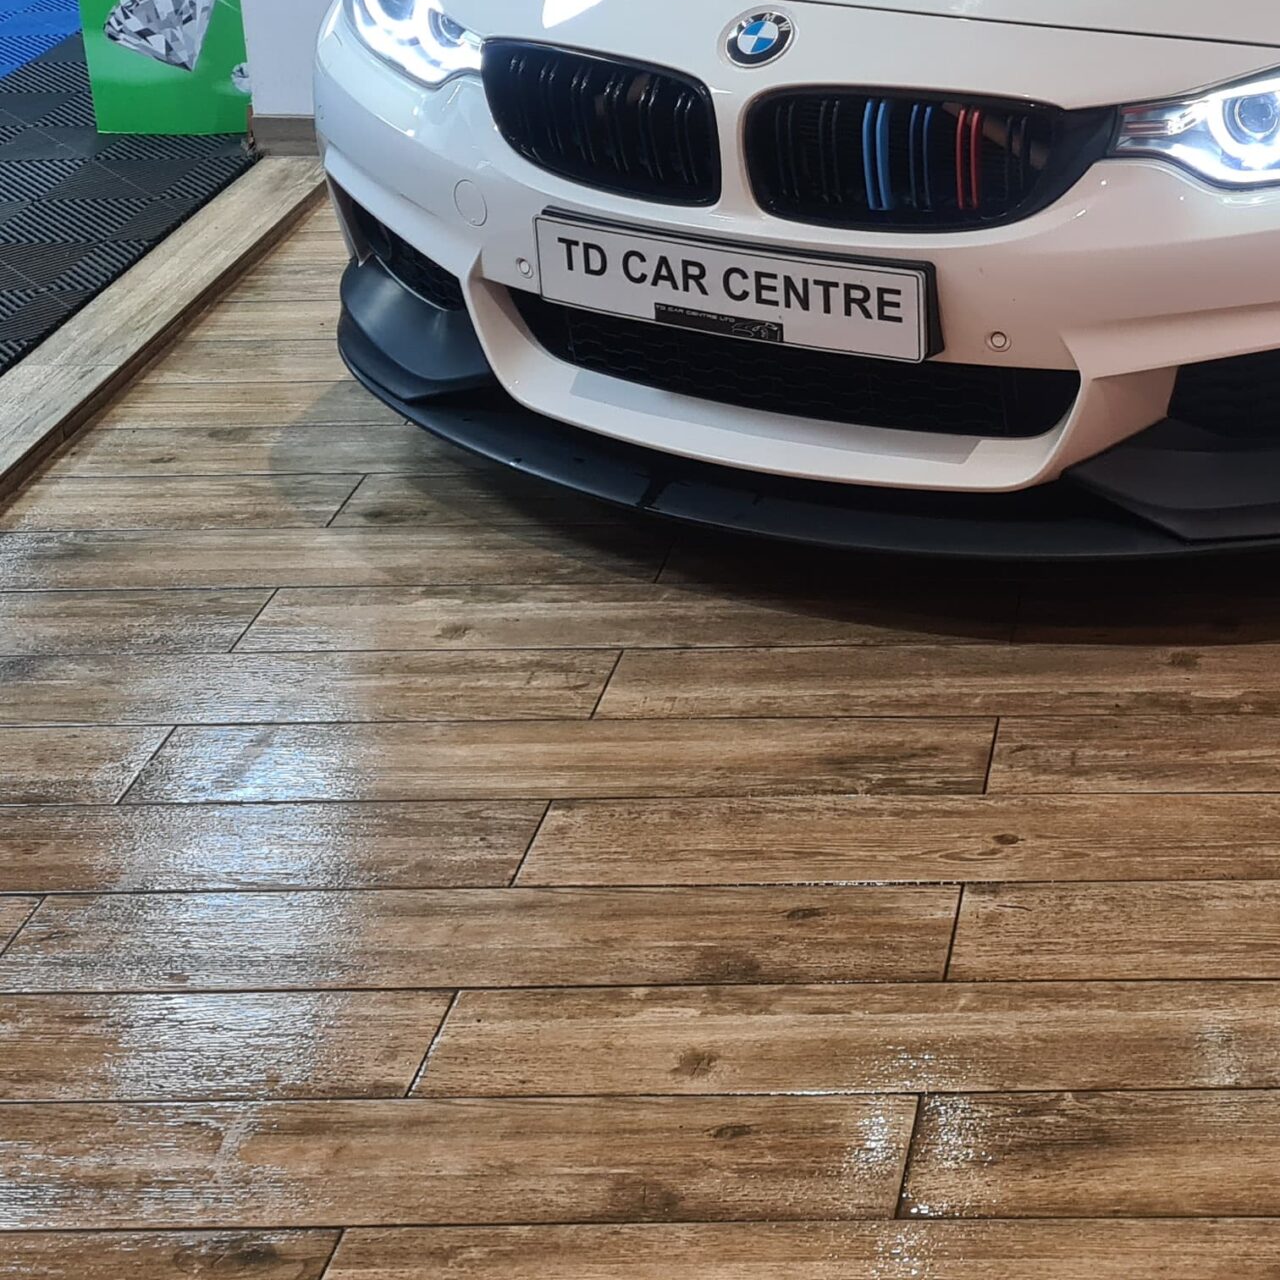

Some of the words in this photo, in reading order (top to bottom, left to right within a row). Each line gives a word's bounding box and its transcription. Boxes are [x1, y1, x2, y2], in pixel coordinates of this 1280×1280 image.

[557, 236, 608, 277] TD
[621, 250, 709, 296] CAR
[721, 266, 904, 323] CENTRE
